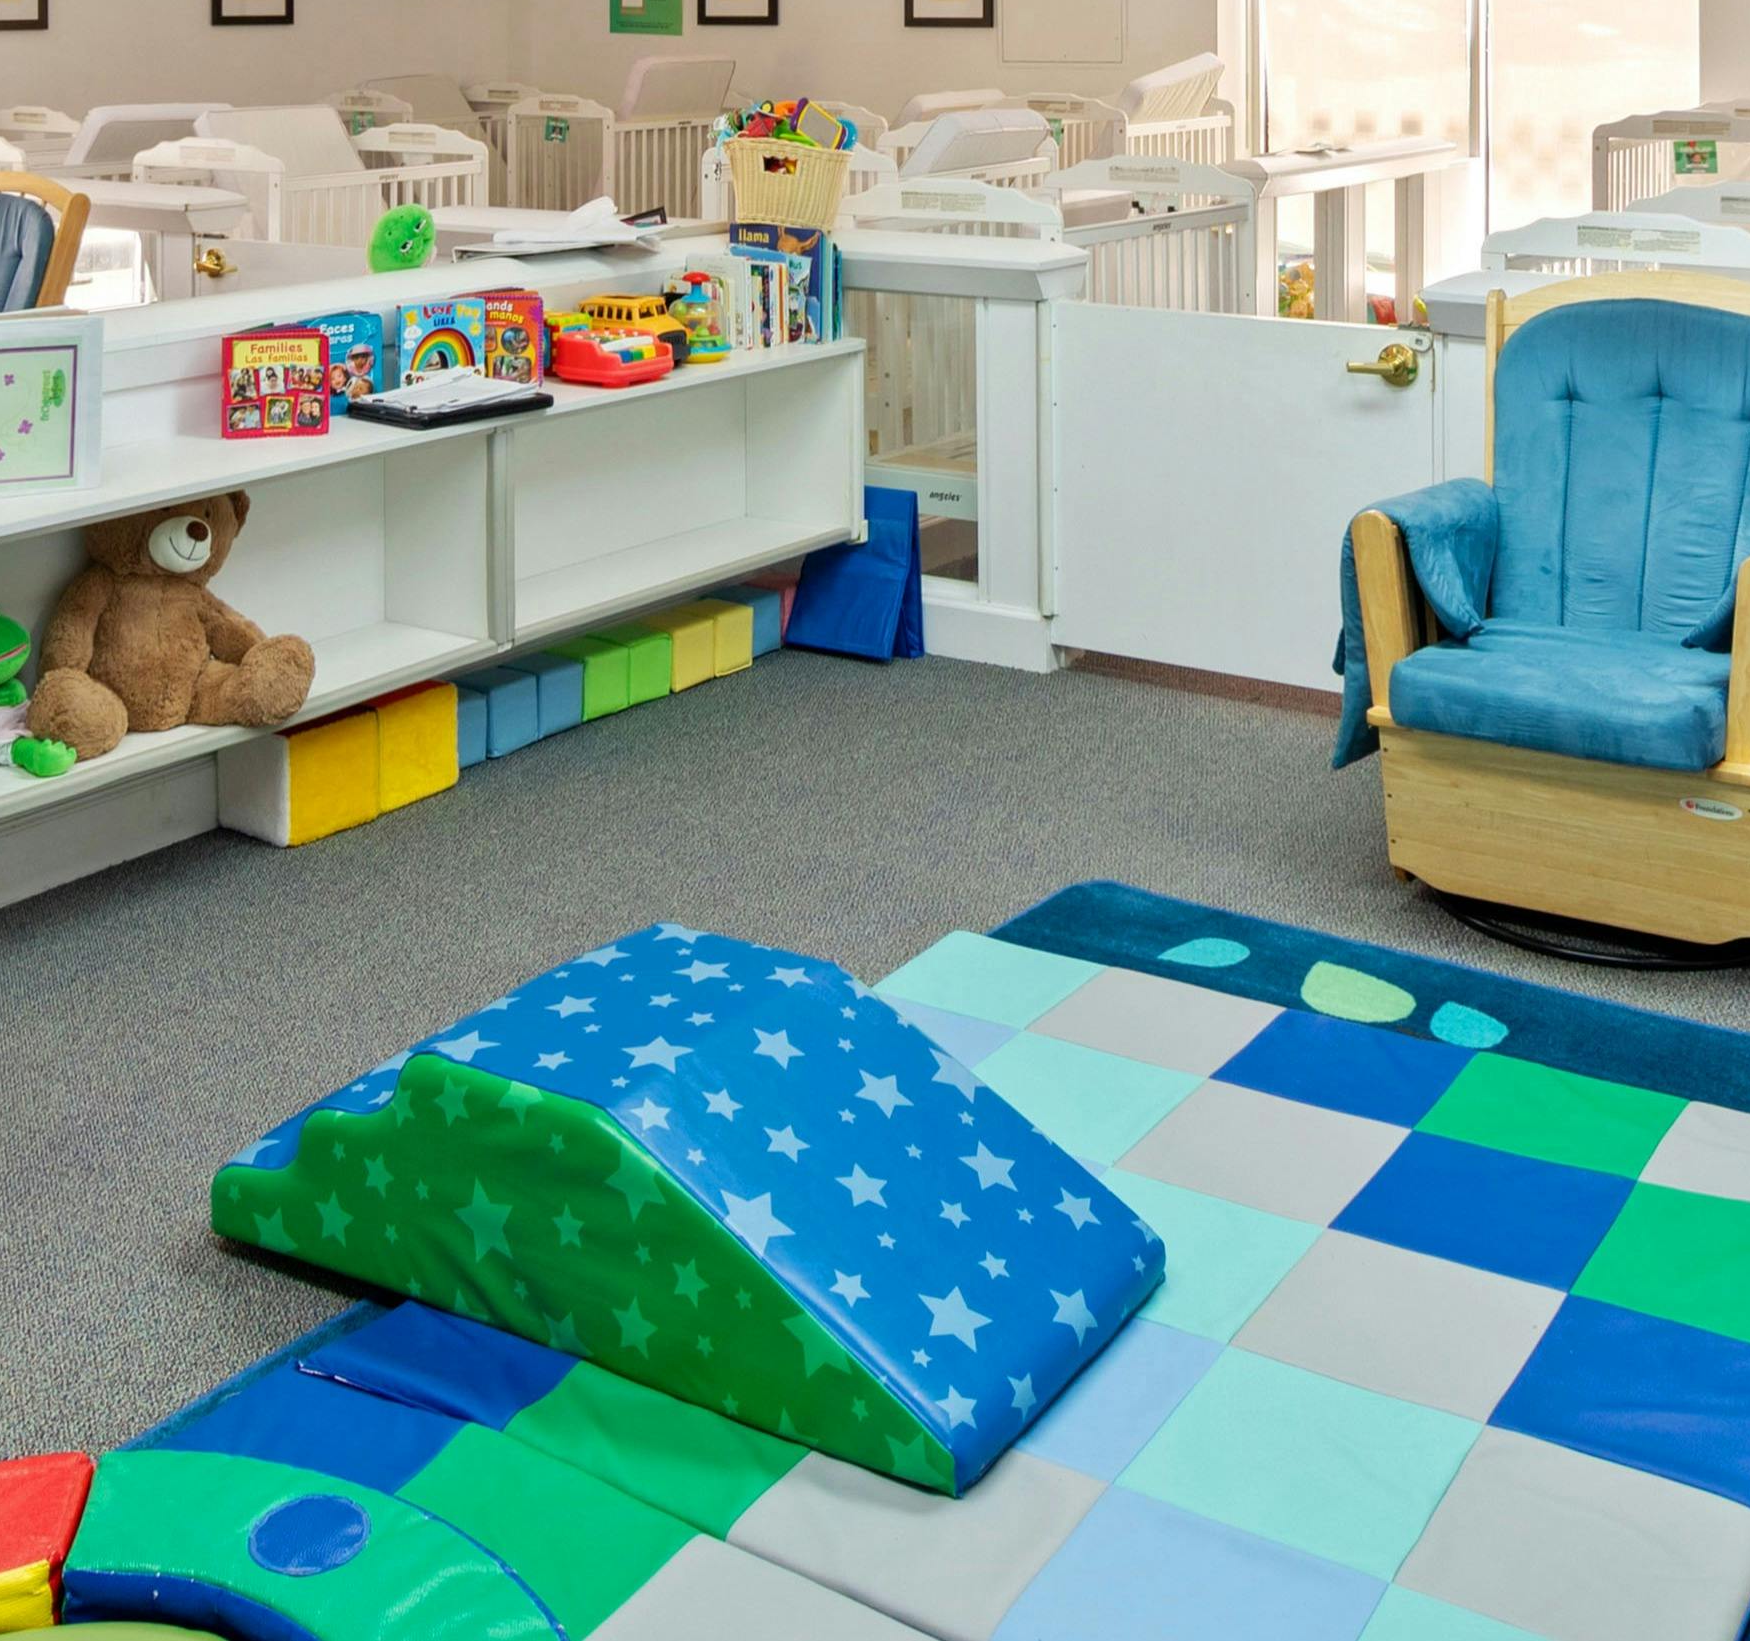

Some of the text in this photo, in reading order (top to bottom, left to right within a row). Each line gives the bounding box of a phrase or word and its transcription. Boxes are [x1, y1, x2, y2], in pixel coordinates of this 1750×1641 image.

[739, 229, 769, 244] llama
[486, 301, 514, 313] ands
[489, 310, 525, 324] manos
[319, 323, 355, 335] Faces
[330, 335, 353, 345] aras
[250, 343, 303, 355] Families
[245, 353, 308, 364] Las familias
